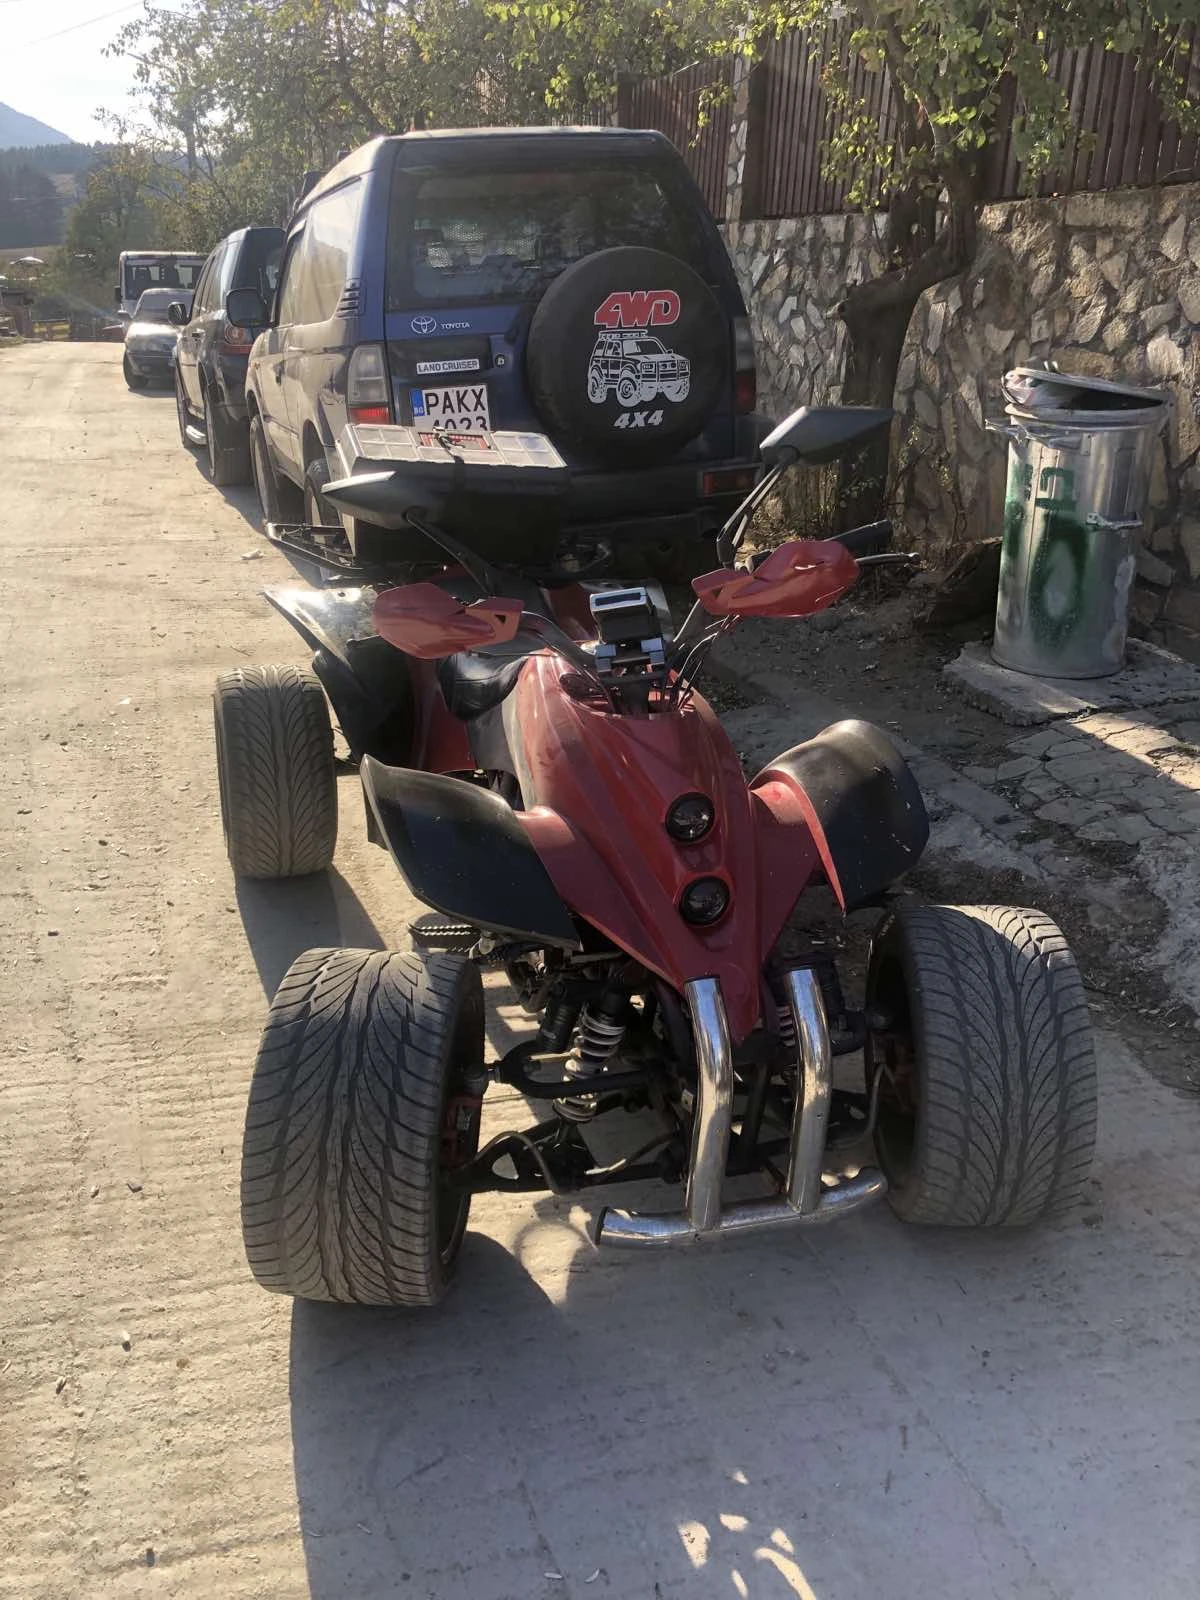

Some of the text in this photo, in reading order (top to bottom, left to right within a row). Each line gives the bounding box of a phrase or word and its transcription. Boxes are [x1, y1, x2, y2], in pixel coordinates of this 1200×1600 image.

[594, 290, 680, 328] 4WD
[418, 360, 478, 373] LAND CRUISER
[424, 388, 486, 415] PAKX
